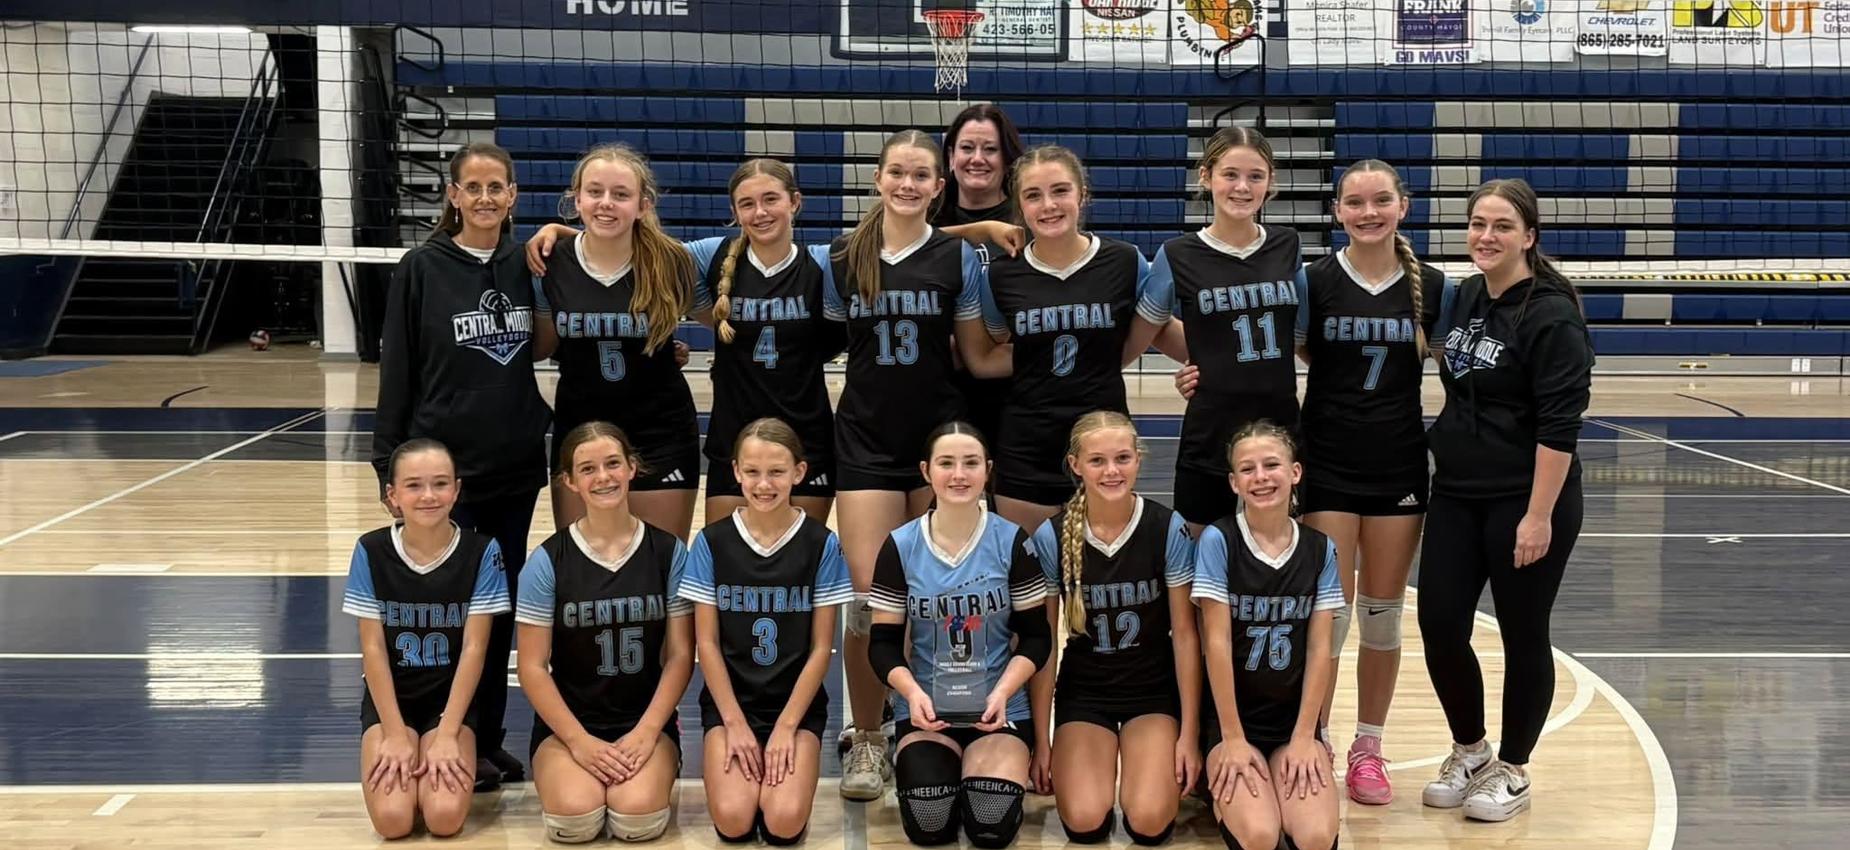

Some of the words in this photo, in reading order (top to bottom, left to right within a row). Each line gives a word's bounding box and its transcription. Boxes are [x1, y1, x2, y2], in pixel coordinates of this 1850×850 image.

[566, 0, 689, 15] HOME
[1097, 8, 1136, 17] NISSAN
[1316, 13, 1356, 22] REALTOR
[1403, 0, 1465, 14] FRANK
[1770, 1, 1820, 33] UT
[1823, 12, 1850, 22] Cred
[1824, 1, 1850, 10] Fede
[982, 23, 1055, 35] 423-566-05
[1587, 16, 1657, 26] CHEVROLET
[1823, 24, 1850, 33] Unio
[1176, 16, 1218, 59] PLUMBIN
[1576, 33, 1607, 49] (865)
[1609, 33, 1666, 49] 285-7021
[1672, 36, 1698, 44] LAND
[1396, 50, 1415, 64] GO
[1419, 50, 1470, 64] MAVS!
[731, 295, 811, 321] ENTRAL
[1197, 280, 1299, 315] CENTRAL
[453, 312, 504, 342] CENTRA
[504, 310, 533, 334] MIDD
[556, 311, 650, 339] CENTRA
[1015, 302, 1116, 337] CENTRAL
[1323, 316, 1415, 342] CENTRA
[752, 325, 779, 369] 4
[873, 319, 919, 366] 13
[1231, 311, 1281, 362] 11
[597, 340, 626, 381] 5
[1051, 334, 1079, 377] 0
[1361, 345, 1388, 390] 7
[716, 584, 812, 612] CENTRAL
[908, 586, 1007, 620] CENTRAL
[1082, 579, 1161, 609] ENTRAL
[563, 594, 666, 628] CENTRAL
[752, 617, 778, 666] 3
[1093, 610, 1141, 655] 12
[595, 626, 645, 676] 15
[1245, 624, 1293, 671] 75
[914, 785, 949, 798] NEENCA
[975, 780, 1010, 793] NEENCA
